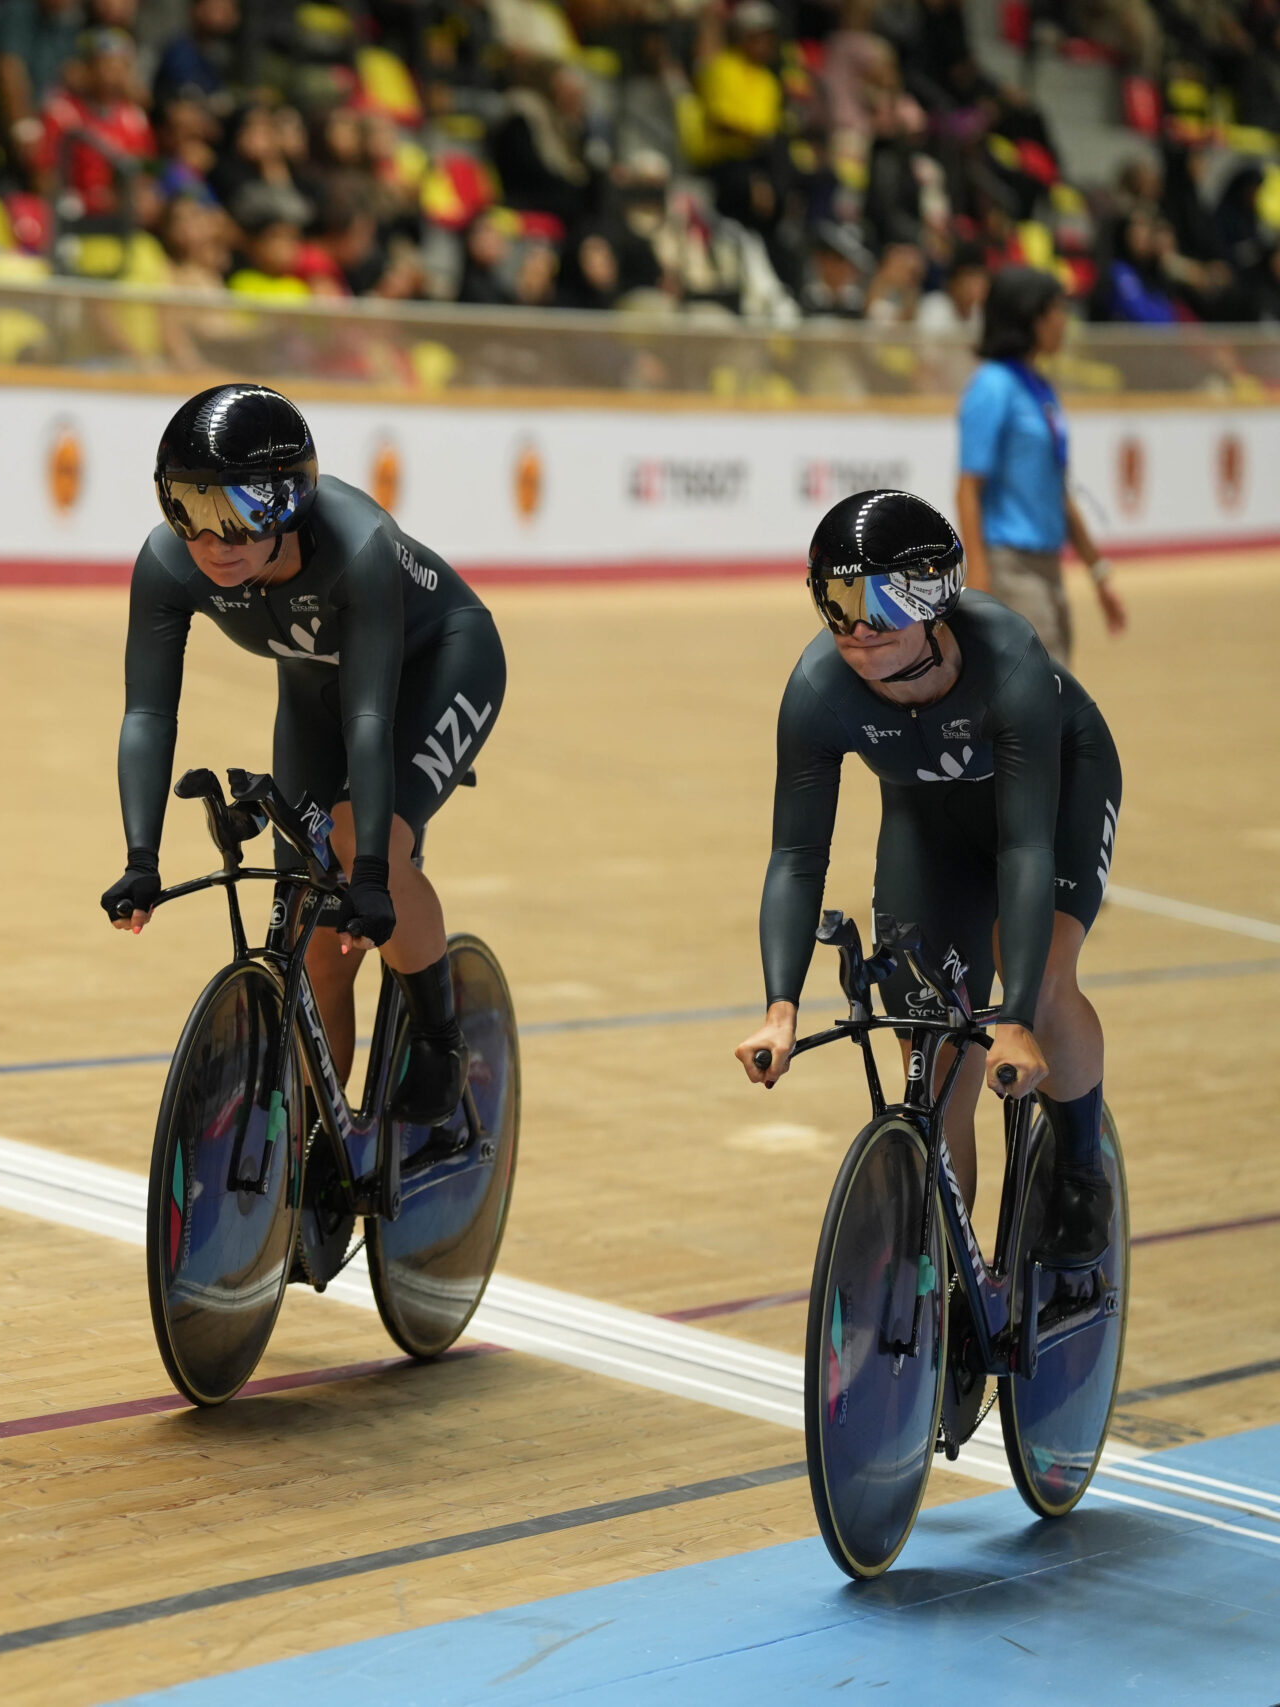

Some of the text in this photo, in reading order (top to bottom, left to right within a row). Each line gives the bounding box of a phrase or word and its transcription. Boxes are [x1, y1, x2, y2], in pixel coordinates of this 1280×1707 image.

[833, 563, 863, 576] KASK
[861, 724, 876, 732] 18
[866, 730, 902, 738] SIXTY
[411, 692, 492, 795] NZL
[181, 1136, 196, 1271] SouthernSpars
